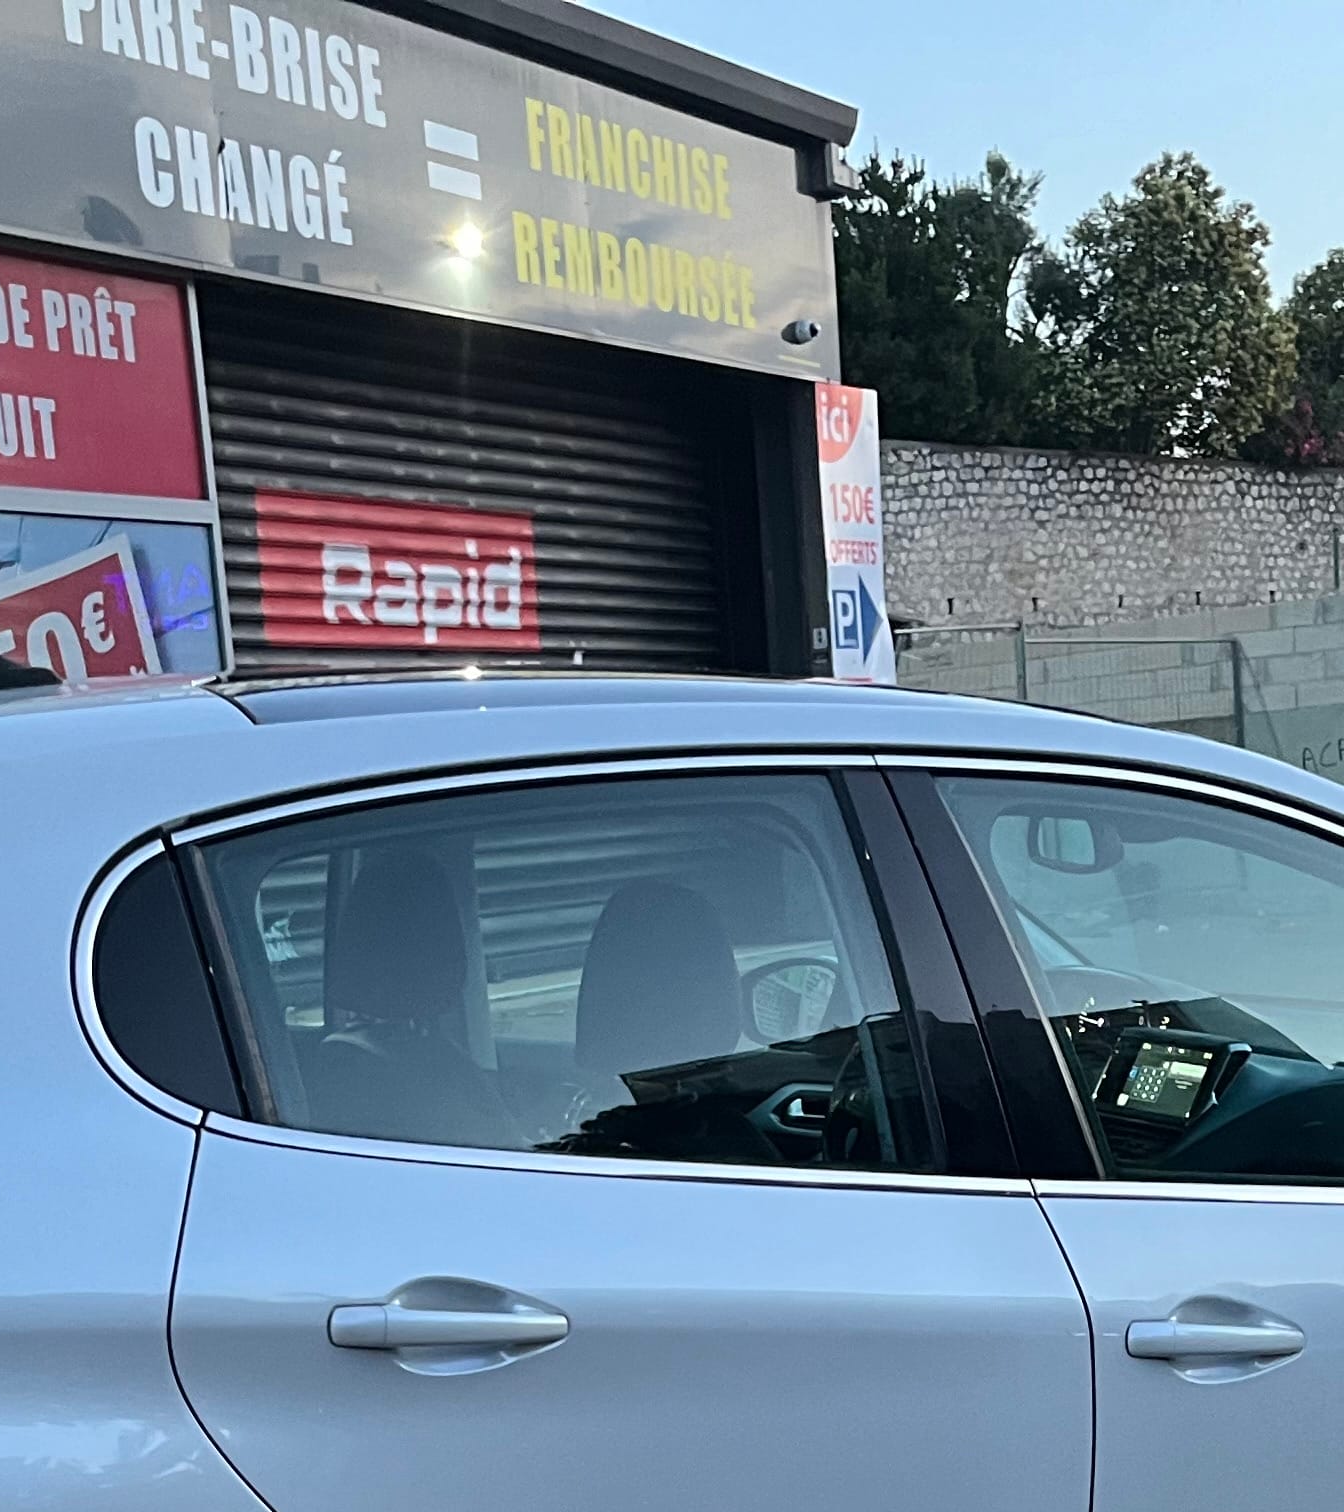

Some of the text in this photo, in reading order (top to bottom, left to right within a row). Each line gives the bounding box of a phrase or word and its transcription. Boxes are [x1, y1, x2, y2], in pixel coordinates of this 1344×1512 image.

[60, 0, 388, 129] PARE-BRISE
[134, 116, 354, 247] CHANGÉ
[525, 97, 732, 220] FRANCHISE
[42, 286, 136, 363] PRÊT
[511, 210, 757, 330] REMBOURSÉE
[820, 391, 850, 443] ici
[829, 482, 876, 526] 150€
[322, 538, 523, 644] Rapid
